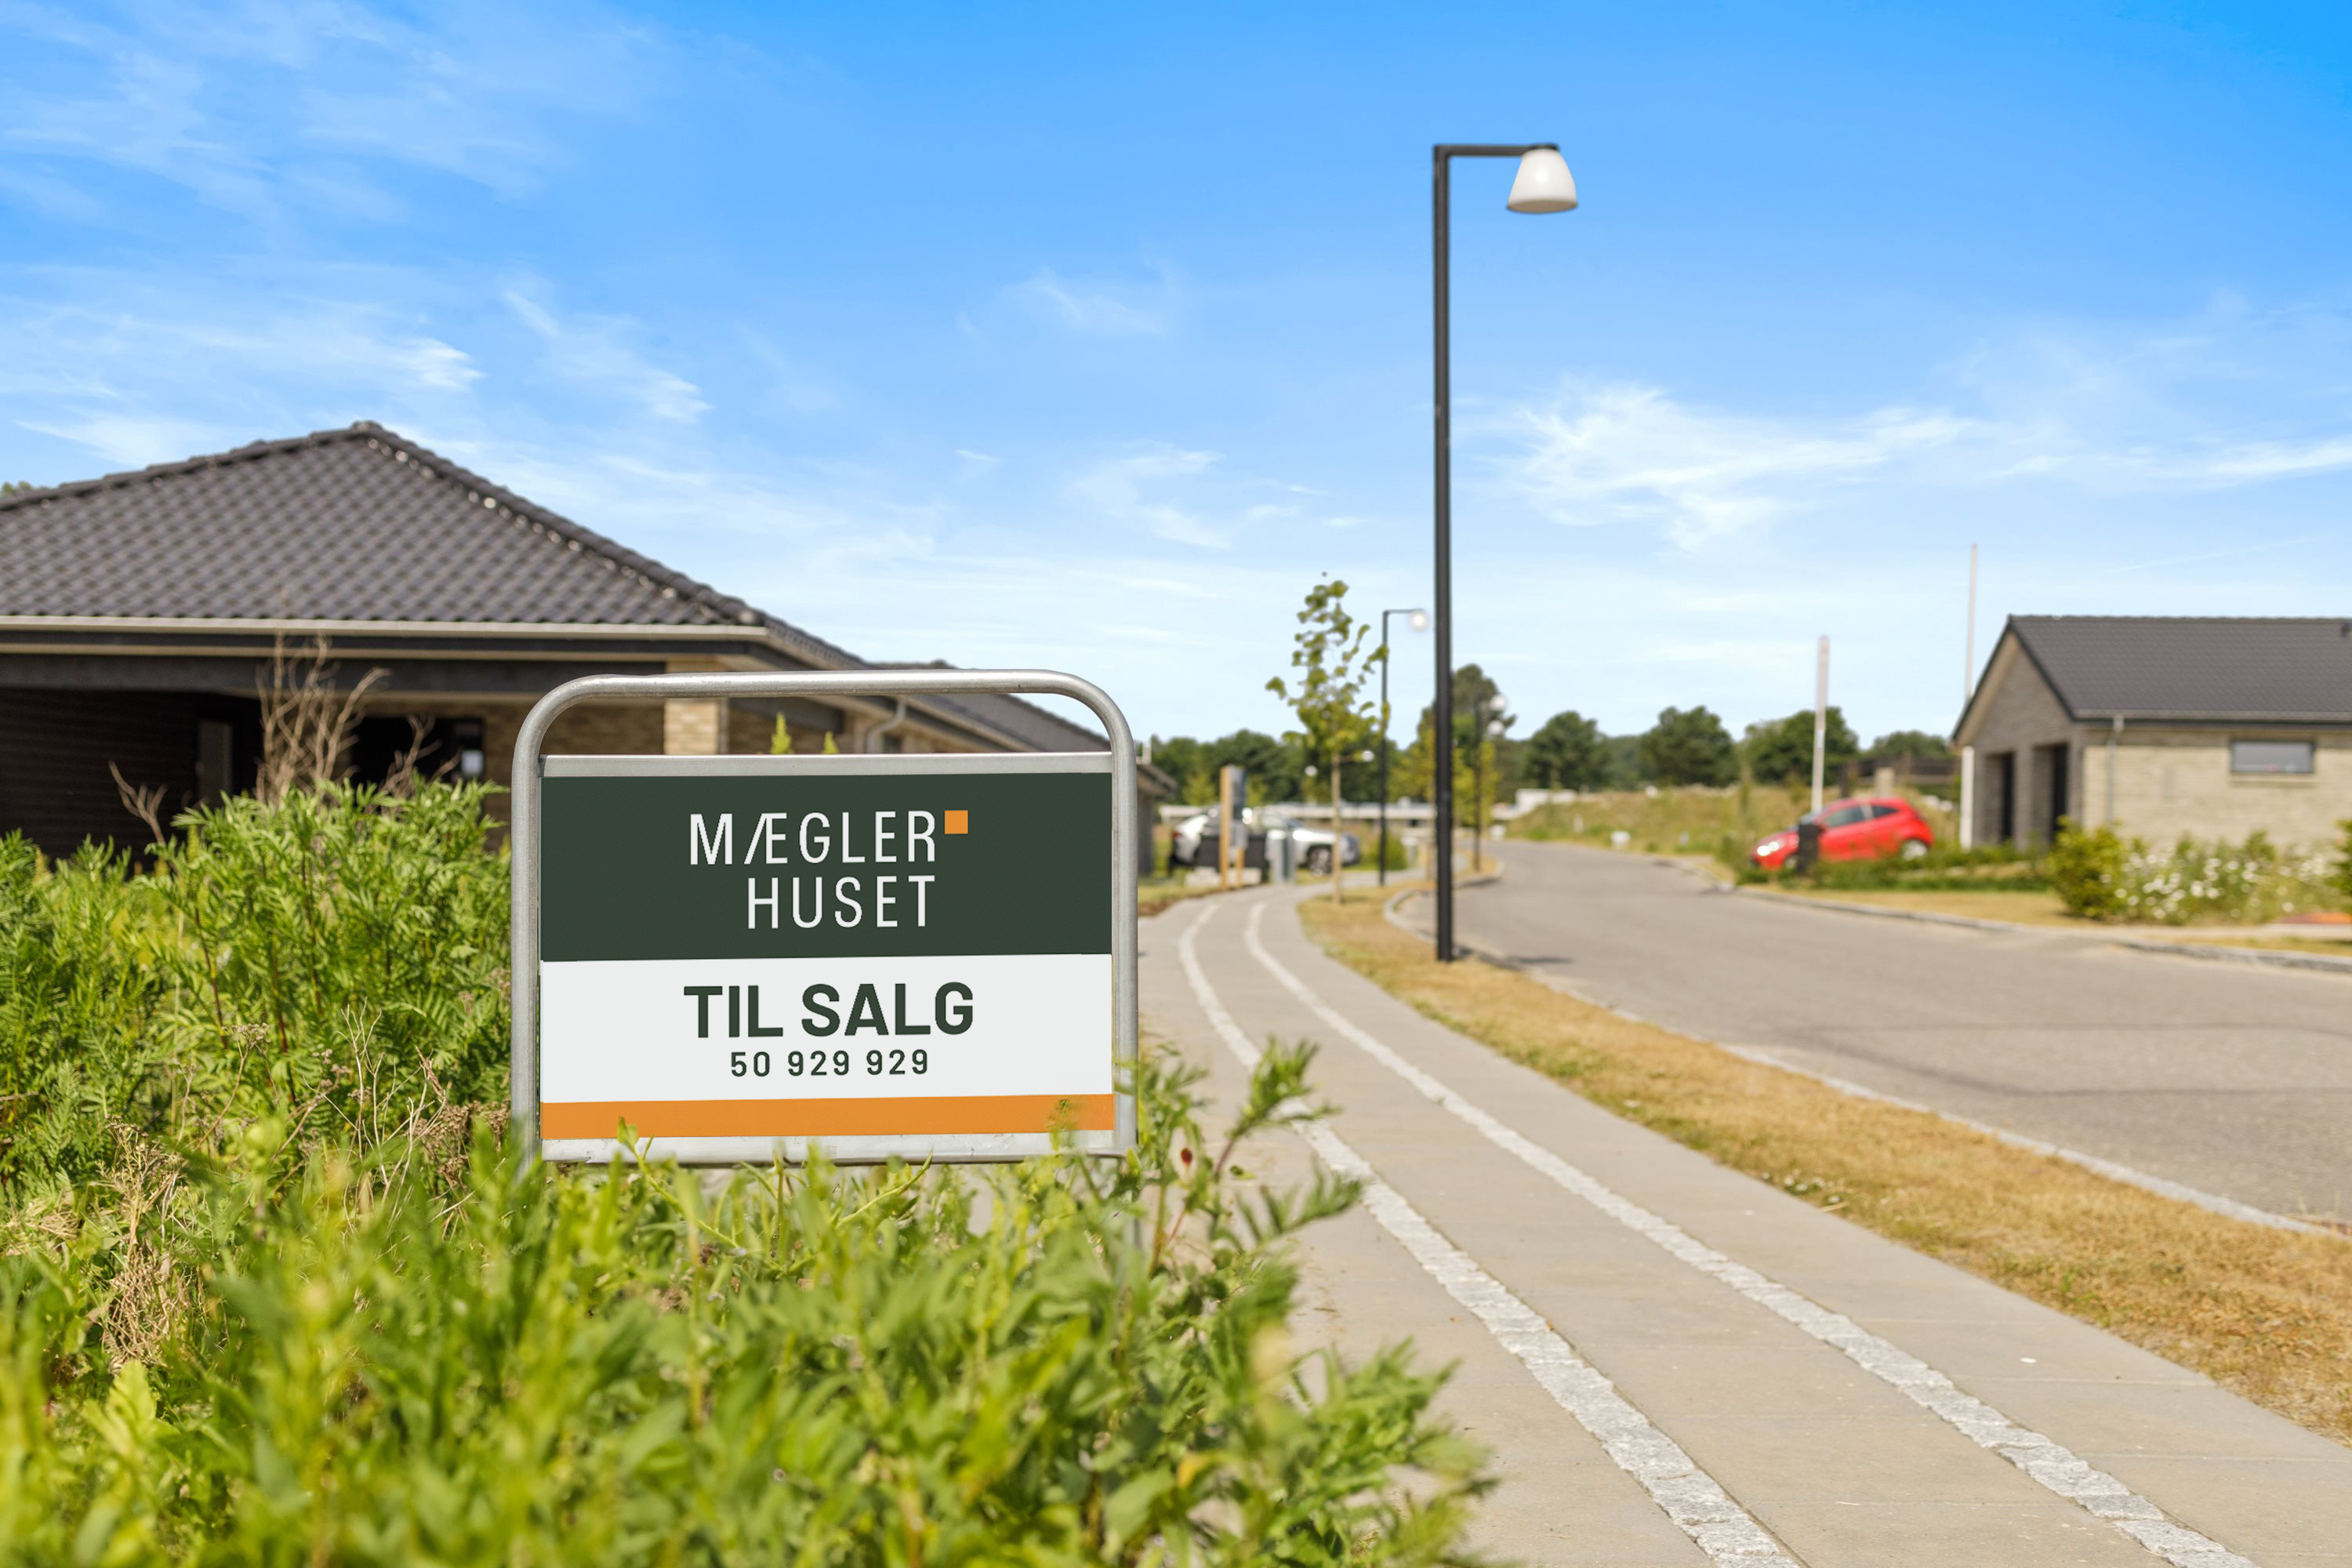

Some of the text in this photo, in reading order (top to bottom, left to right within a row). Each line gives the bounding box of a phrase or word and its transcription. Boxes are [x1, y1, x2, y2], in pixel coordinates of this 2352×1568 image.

[690, 810, 935, 866] MÆGLER
[748, 875, 935, 929] HUSET
[684, 982, 974, 1038] TIL SALG
[731, 1049, 927, 1077] 50 929 929
